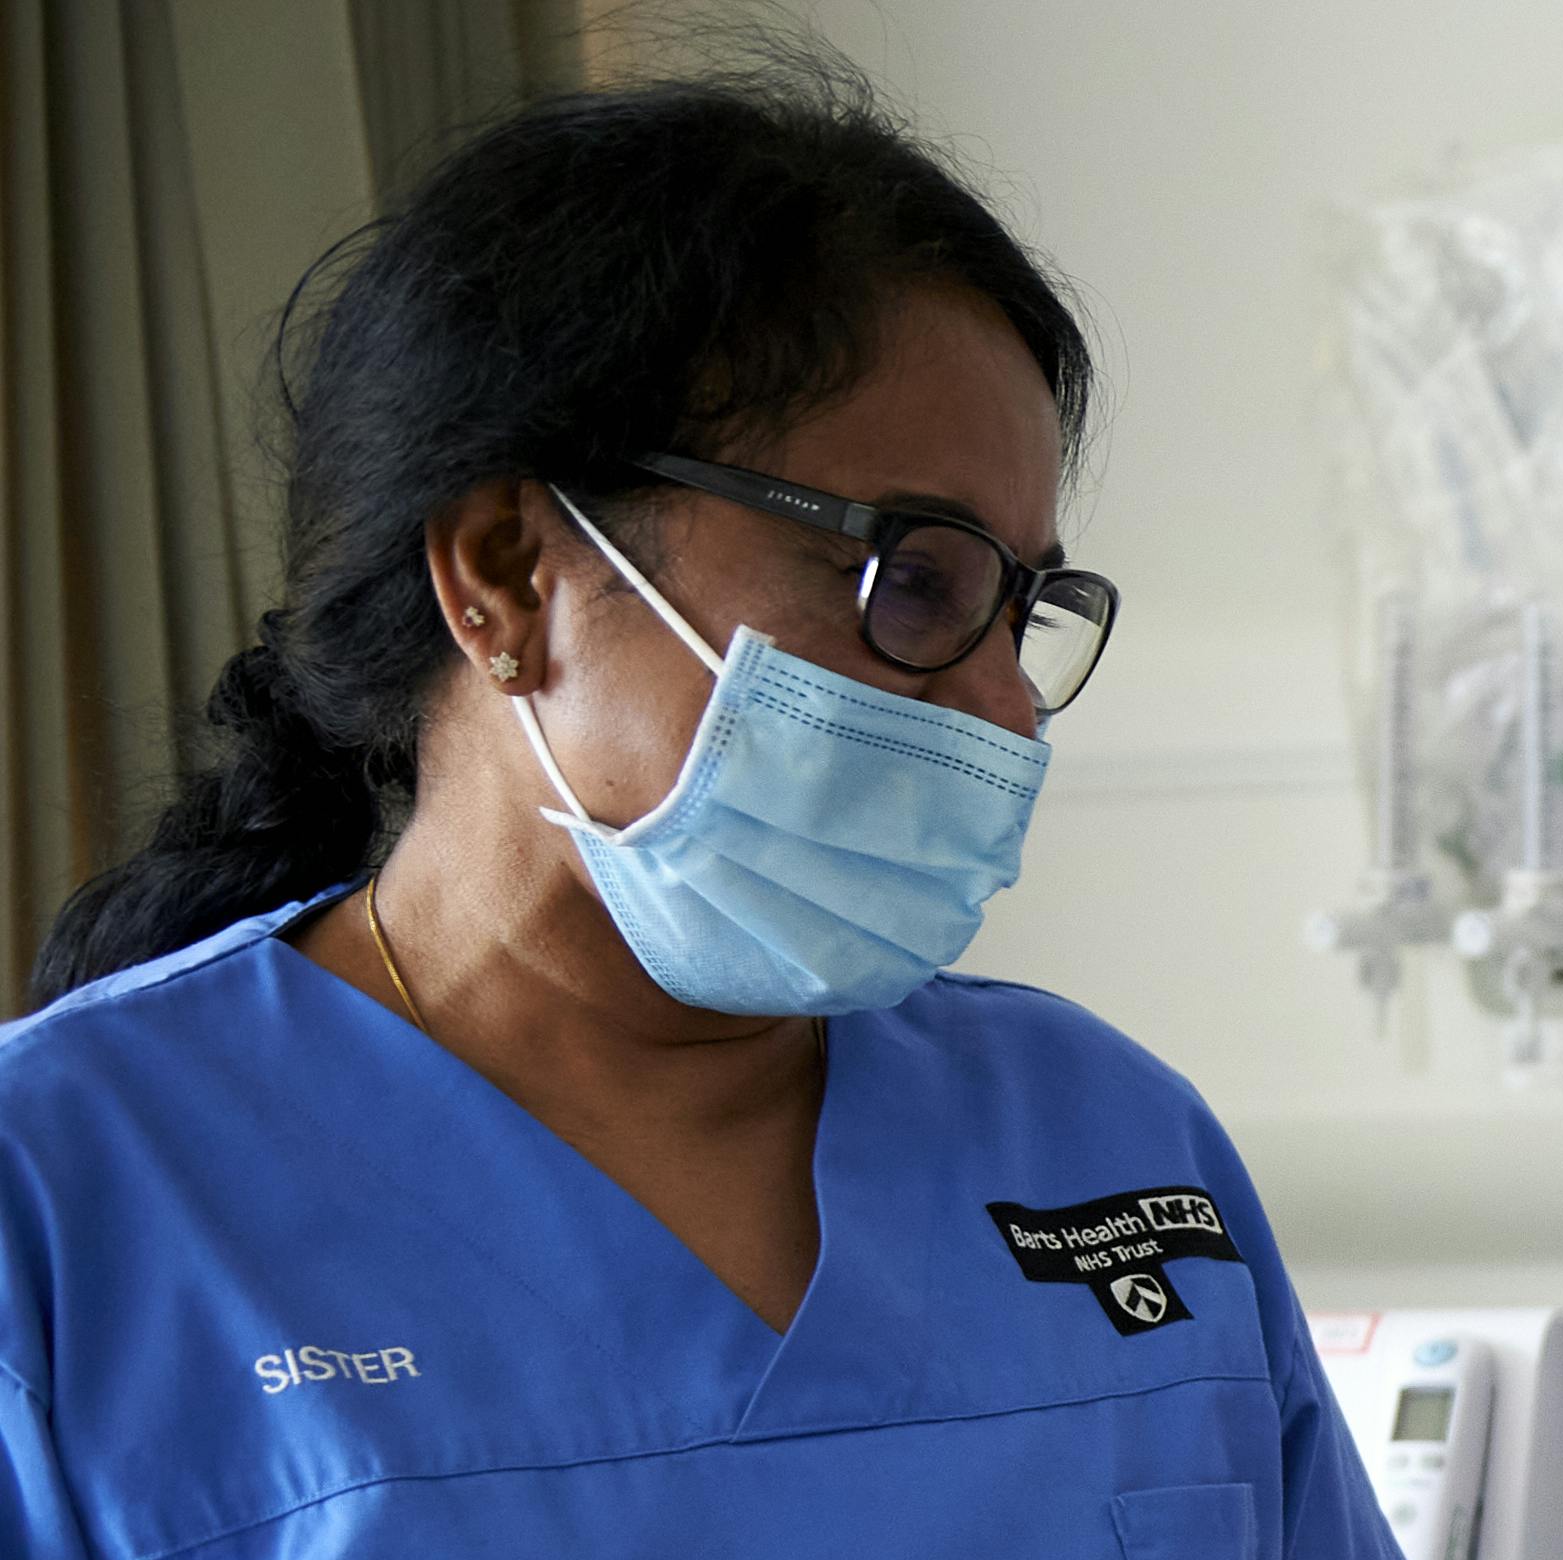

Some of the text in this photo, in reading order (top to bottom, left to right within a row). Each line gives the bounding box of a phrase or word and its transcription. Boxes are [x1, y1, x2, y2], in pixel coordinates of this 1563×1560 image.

[1009, 1198, 1219, 1250] Barts Health NHS
[1074, 1239, 1164, 1272] NHS Trust
[254, 1346, 422, 1395] SISTER
